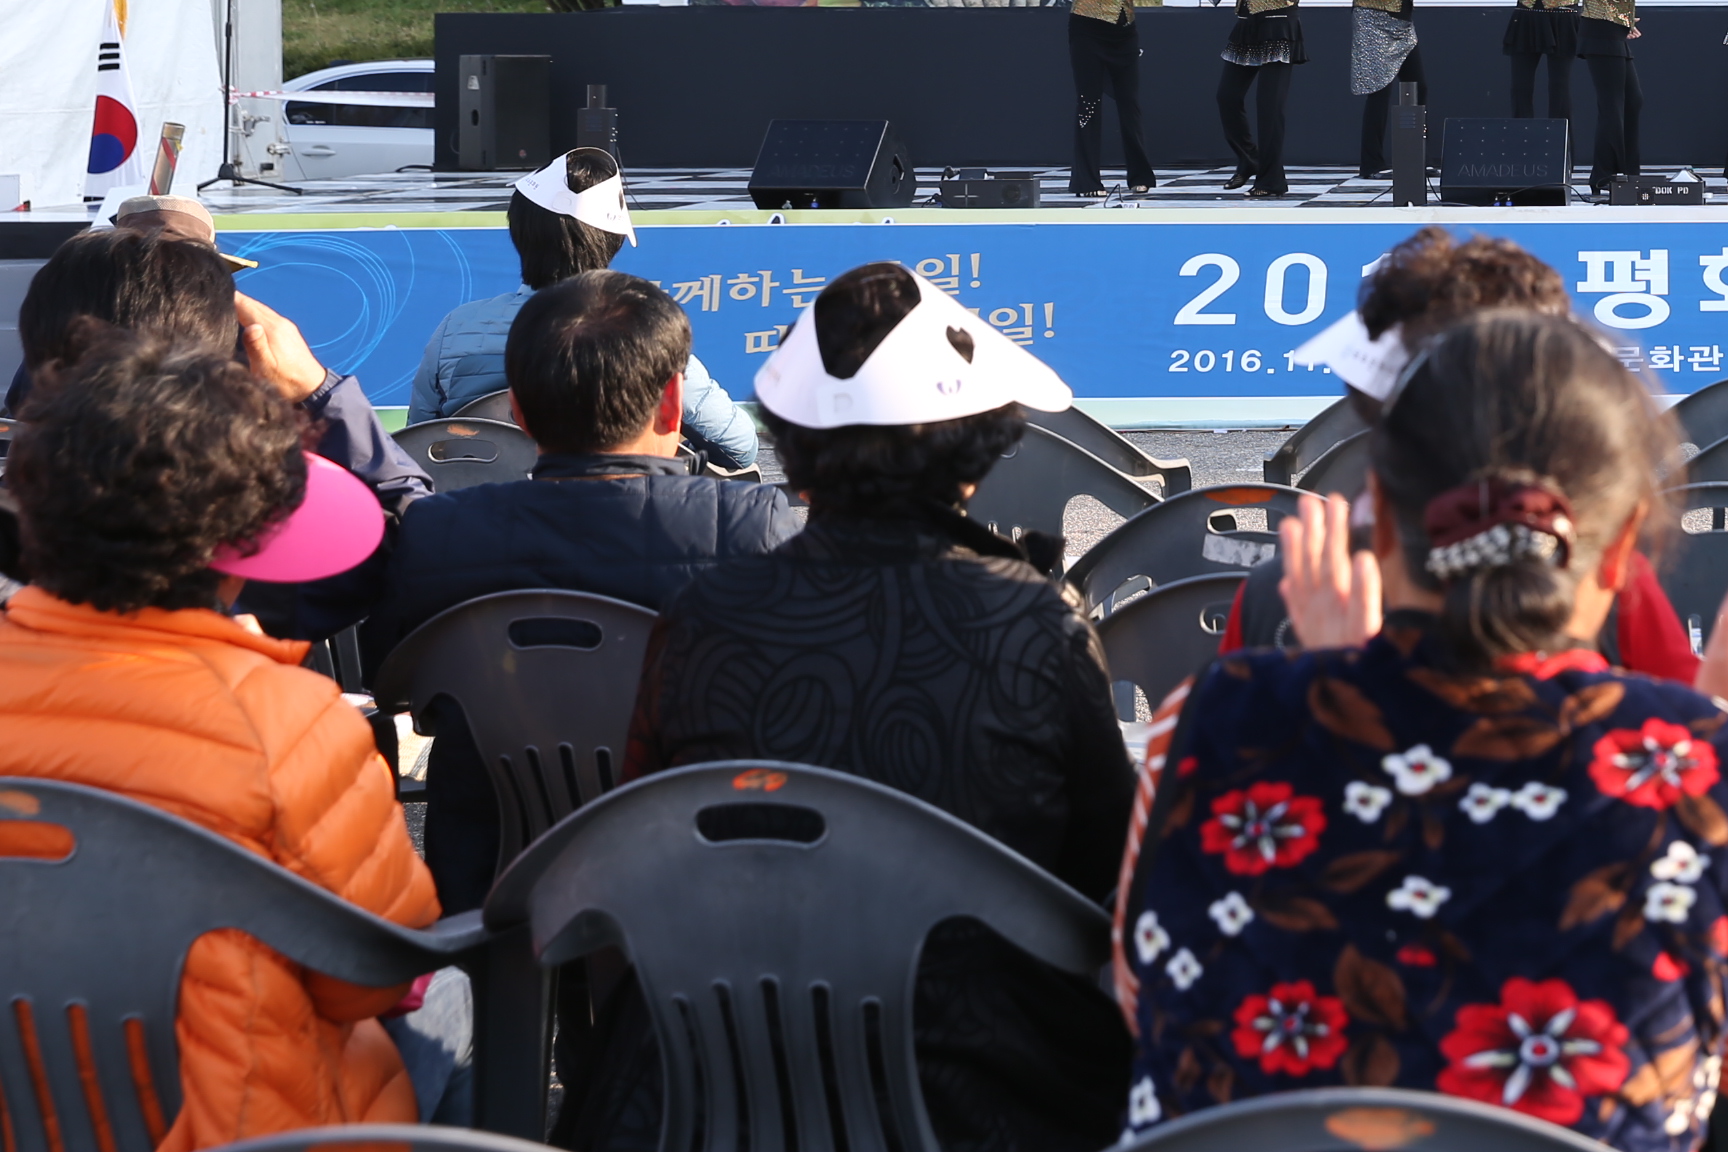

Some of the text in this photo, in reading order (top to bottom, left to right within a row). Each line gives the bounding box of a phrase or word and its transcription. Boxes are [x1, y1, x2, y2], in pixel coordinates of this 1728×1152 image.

[1457, 163, 1549, 177] AMADEUS
[650, 252, 982, 313] 께하는 일!
[967, 301, 1056, 346] 일!
